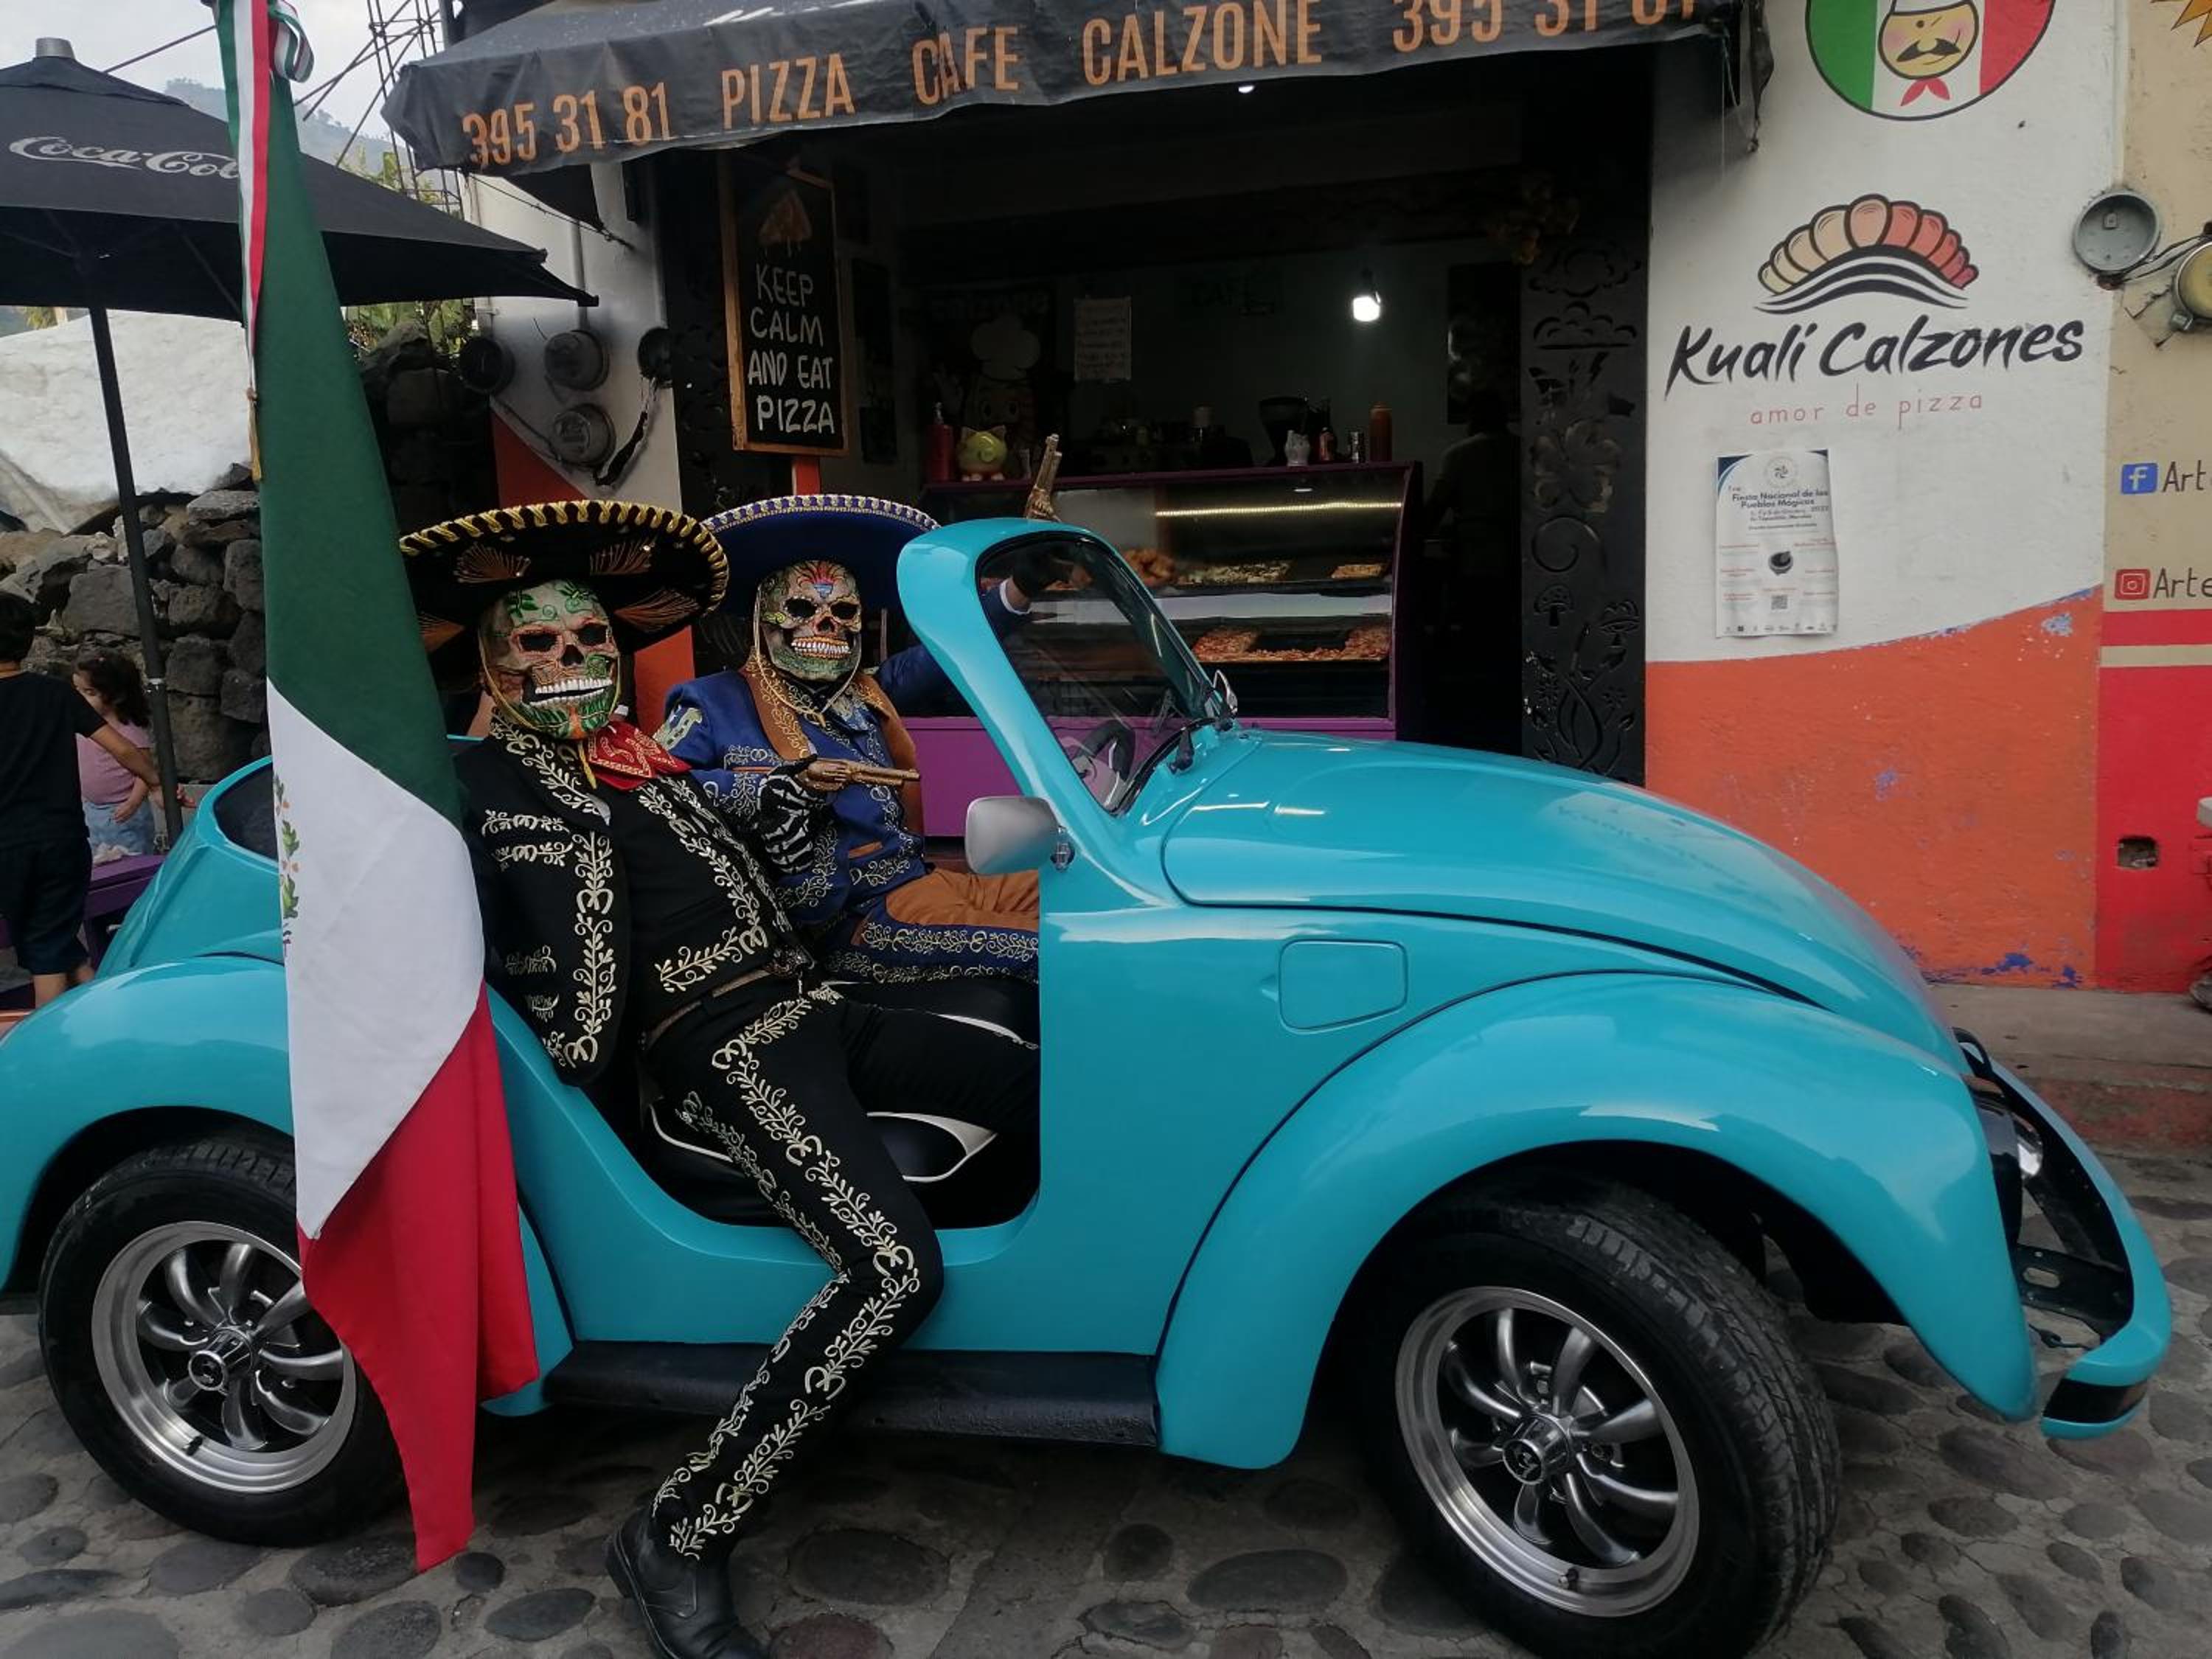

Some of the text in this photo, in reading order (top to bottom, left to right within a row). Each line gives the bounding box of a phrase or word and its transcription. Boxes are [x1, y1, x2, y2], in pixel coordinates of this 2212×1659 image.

[462, 102, 538, 167] 395
[552, 90, 603, 153] 31
[622, 81, 671, 147] 81
[722, 52, 856, 131] PIZZA
[911, 27, 1019, 105] CAFE
[1082, 0, 1323, 86] CALZONE
[9, 136, 240, 179] Coca-Col
[755, 263, 814, 307] KEEP
[750, 306, 824, 347] CALM
[748, 349, 834, 390] AND EAT
[1663, 314, 2084, 402] Kuali Calzones
[757, 394, 835, 435] PIZZA
[1749, 382, 1983, 430] amor de pizza
[2162, 459, 2212, 493] Art
